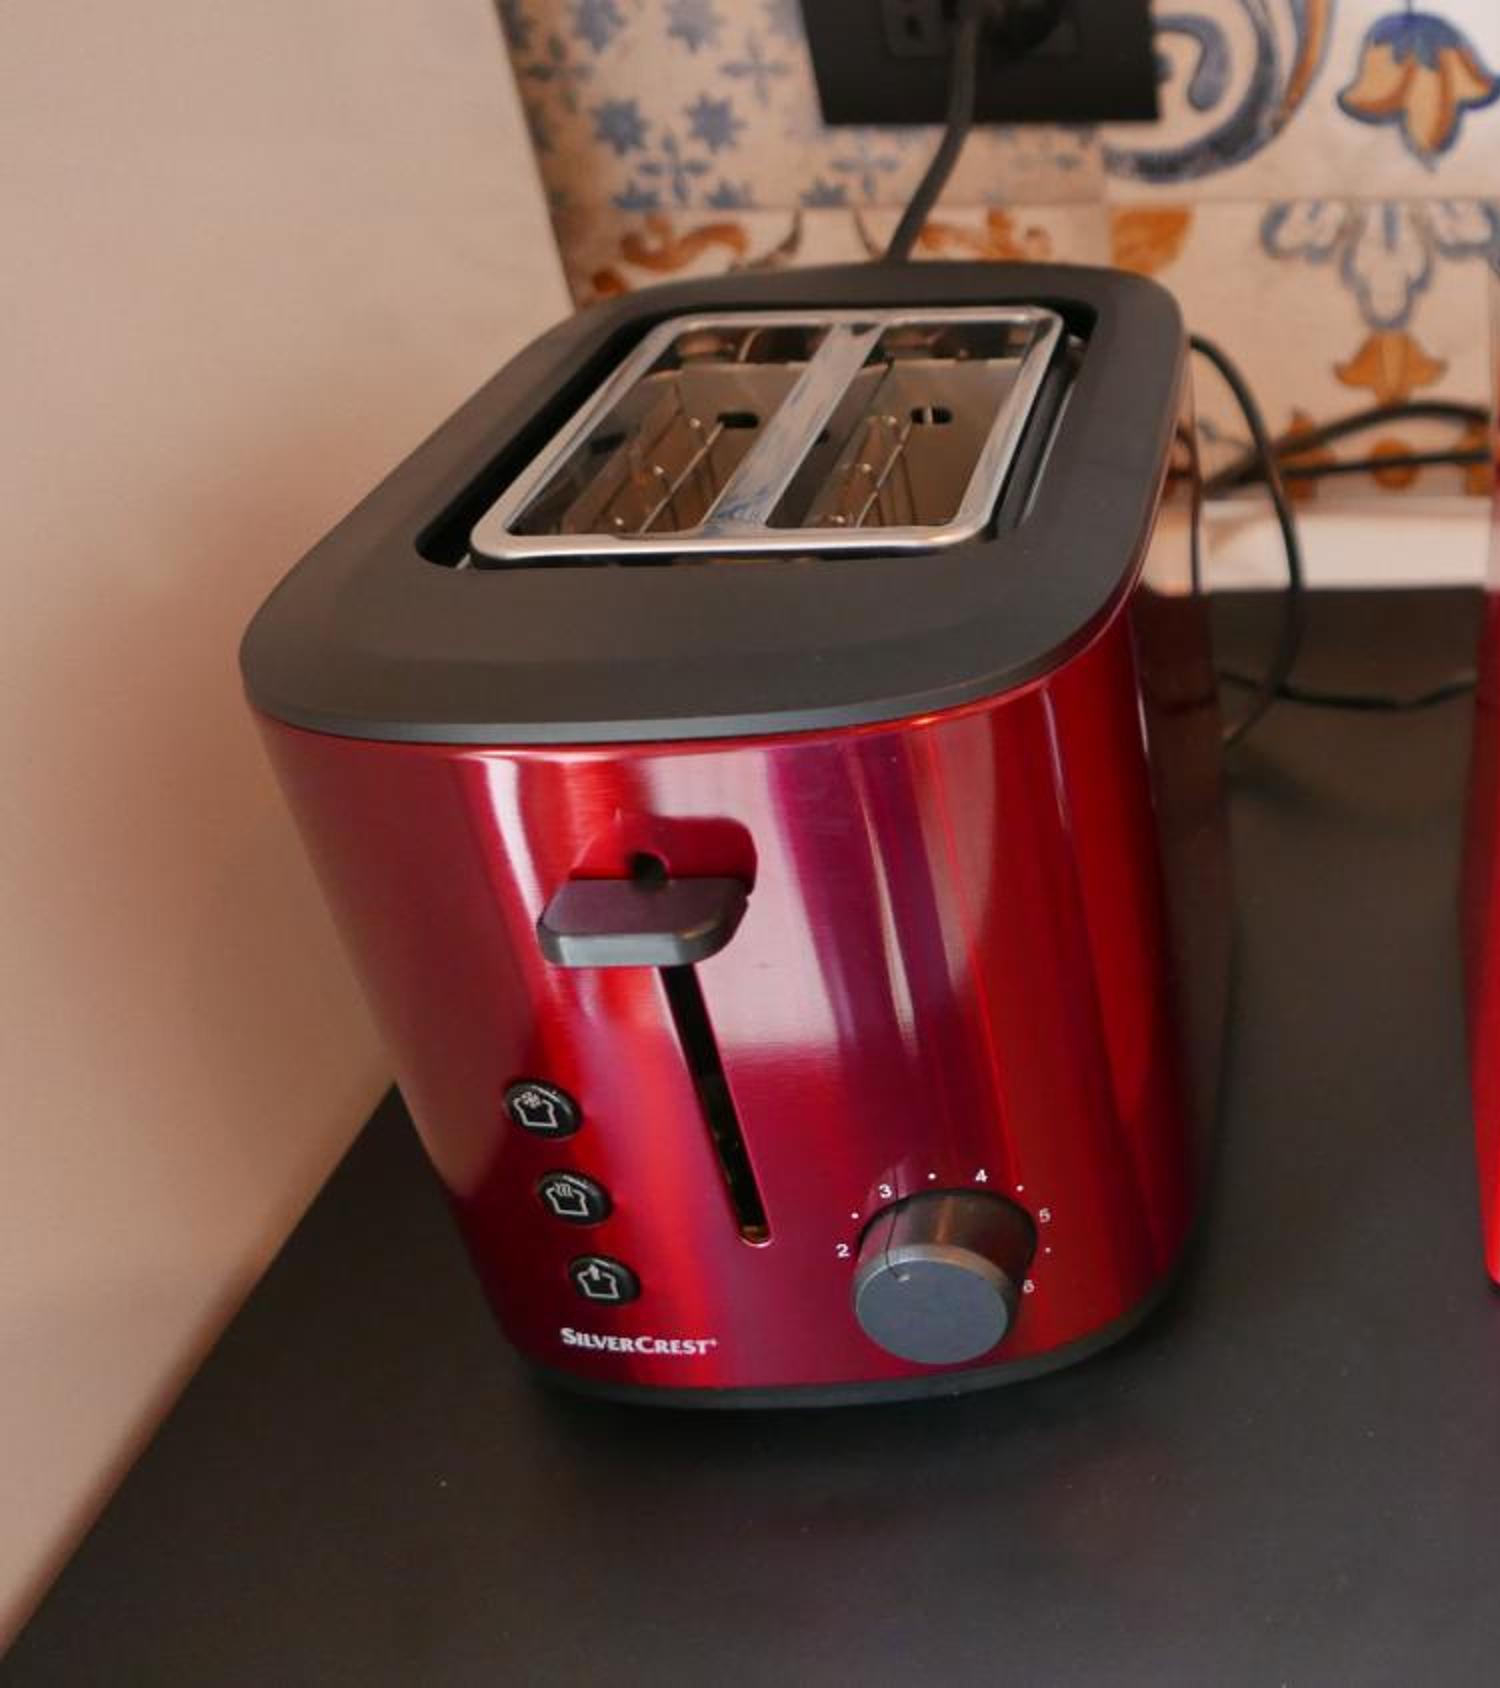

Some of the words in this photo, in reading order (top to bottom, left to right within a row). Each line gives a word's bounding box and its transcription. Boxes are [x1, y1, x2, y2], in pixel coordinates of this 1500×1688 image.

[975, 1169, 989, 1183] 4
[879, 1184, 893, 1198] 3
[1039, 1208, 1051, 1223] 5
[836, 1243, 850, 1258] 2
